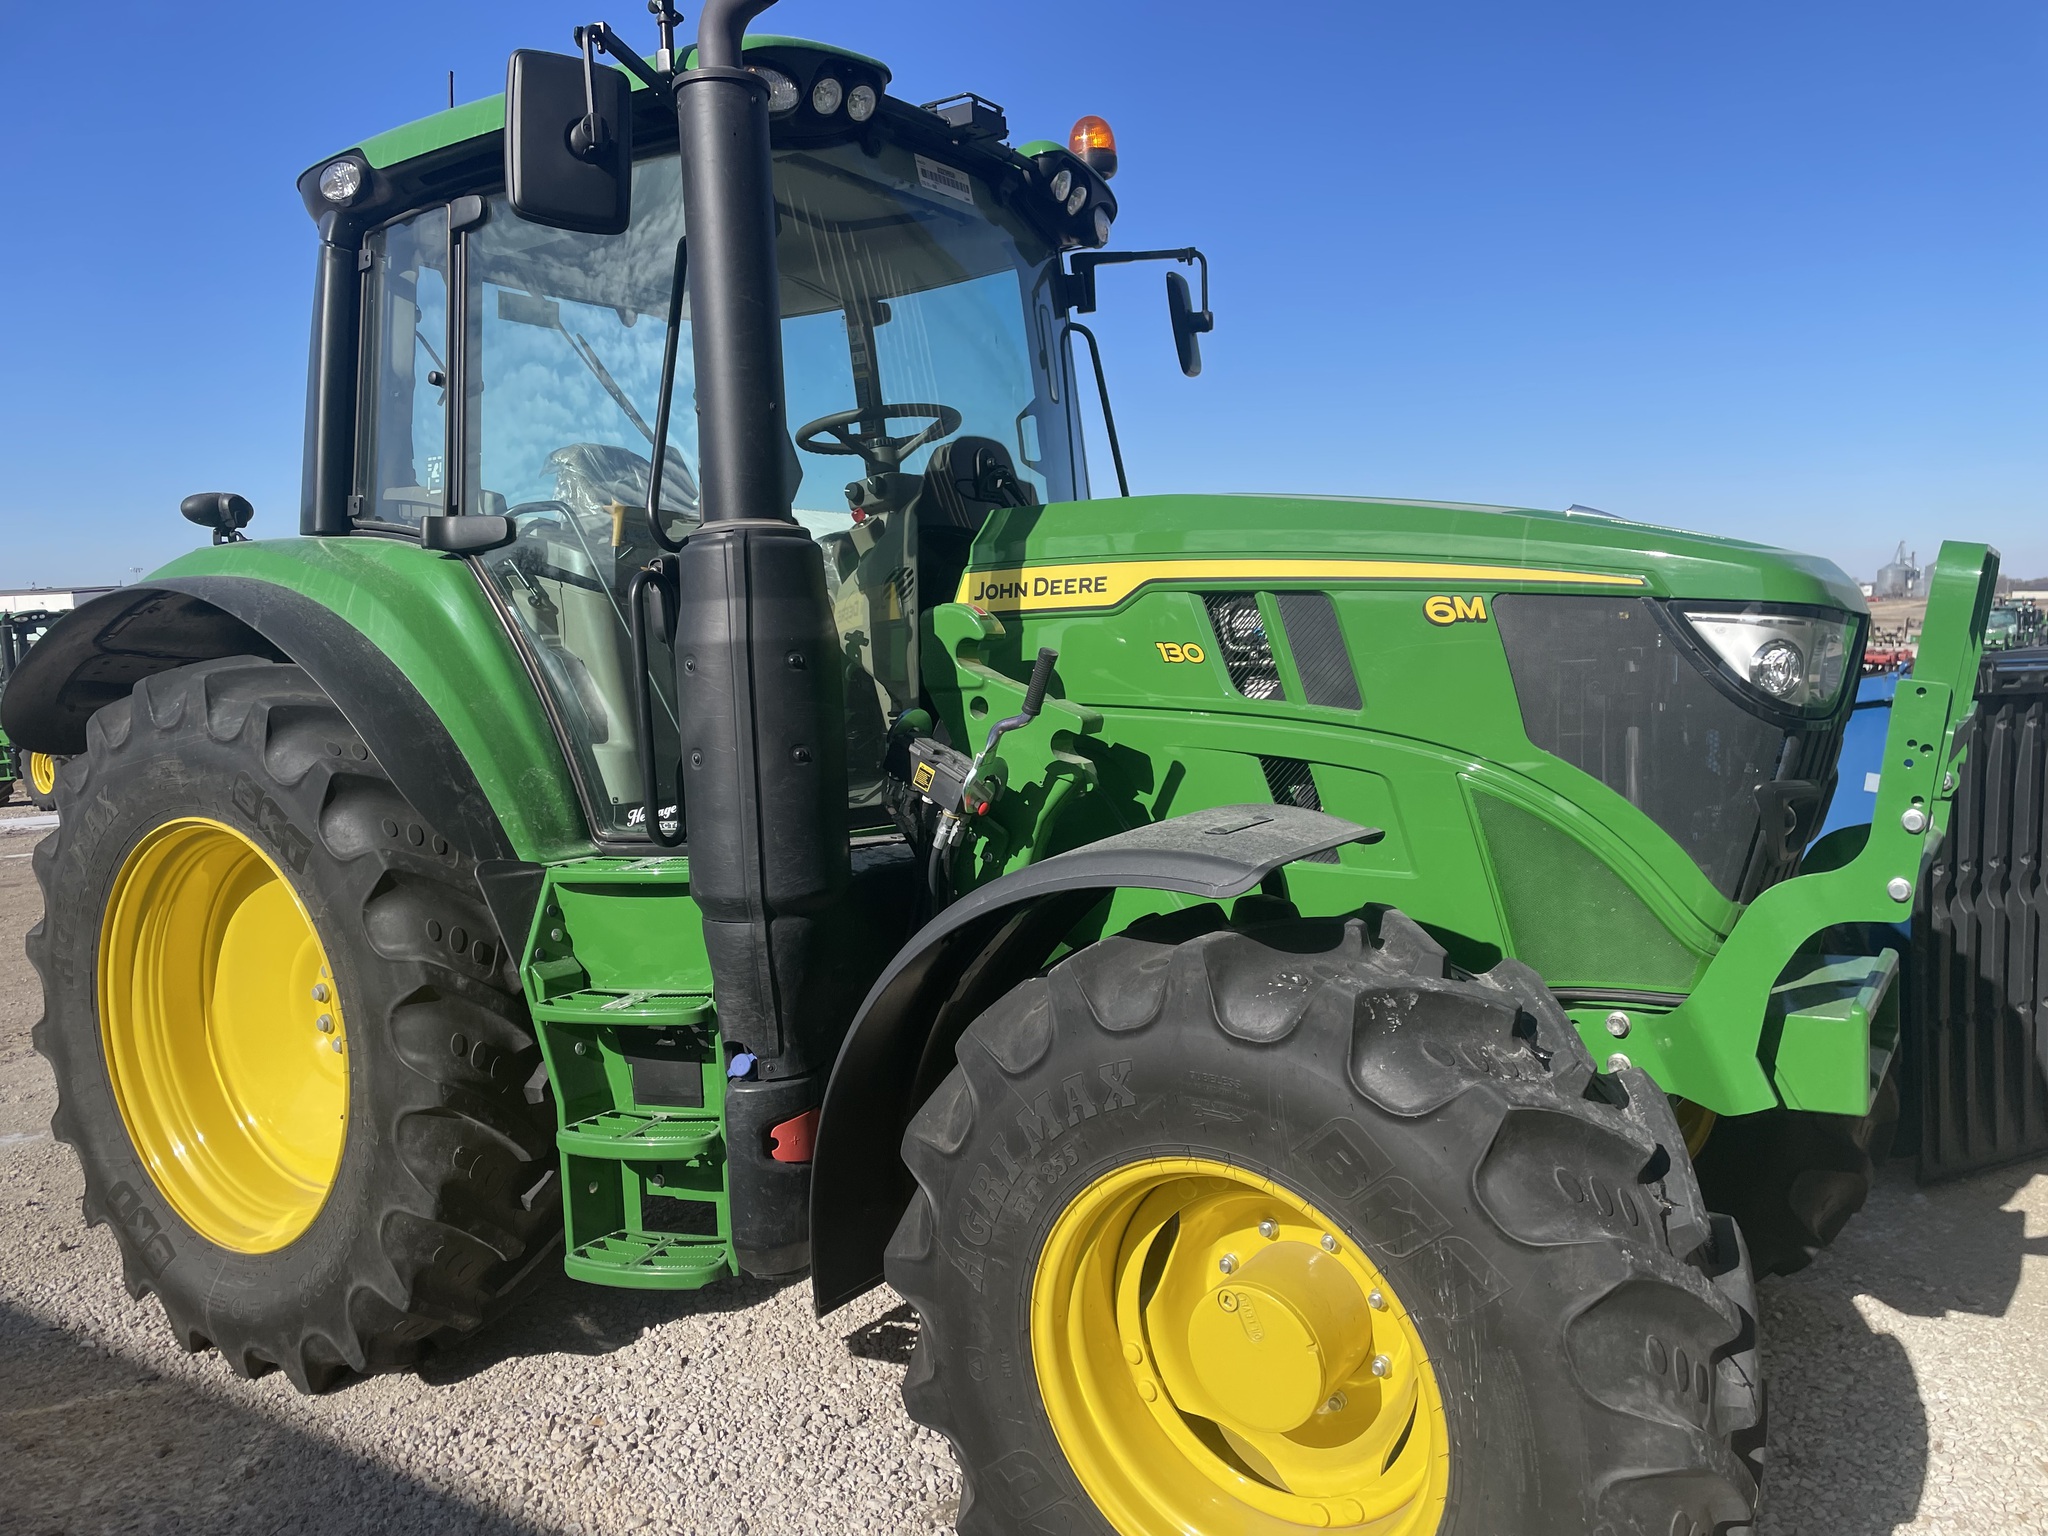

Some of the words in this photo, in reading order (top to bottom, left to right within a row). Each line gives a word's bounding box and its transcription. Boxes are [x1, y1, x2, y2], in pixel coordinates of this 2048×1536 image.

[974, 579, 1027, 601] JOHN
[1033, 575, 1107, 597] DEERE
[1423, 594, 1489, 627] 6M
[1156, 641, 1206, 665] 130
[626, 805, 677, 827] Heage
[953, 1059, 1137, 1293] AGRIMAX
[1040, 1143, 1080, 1184] 855
